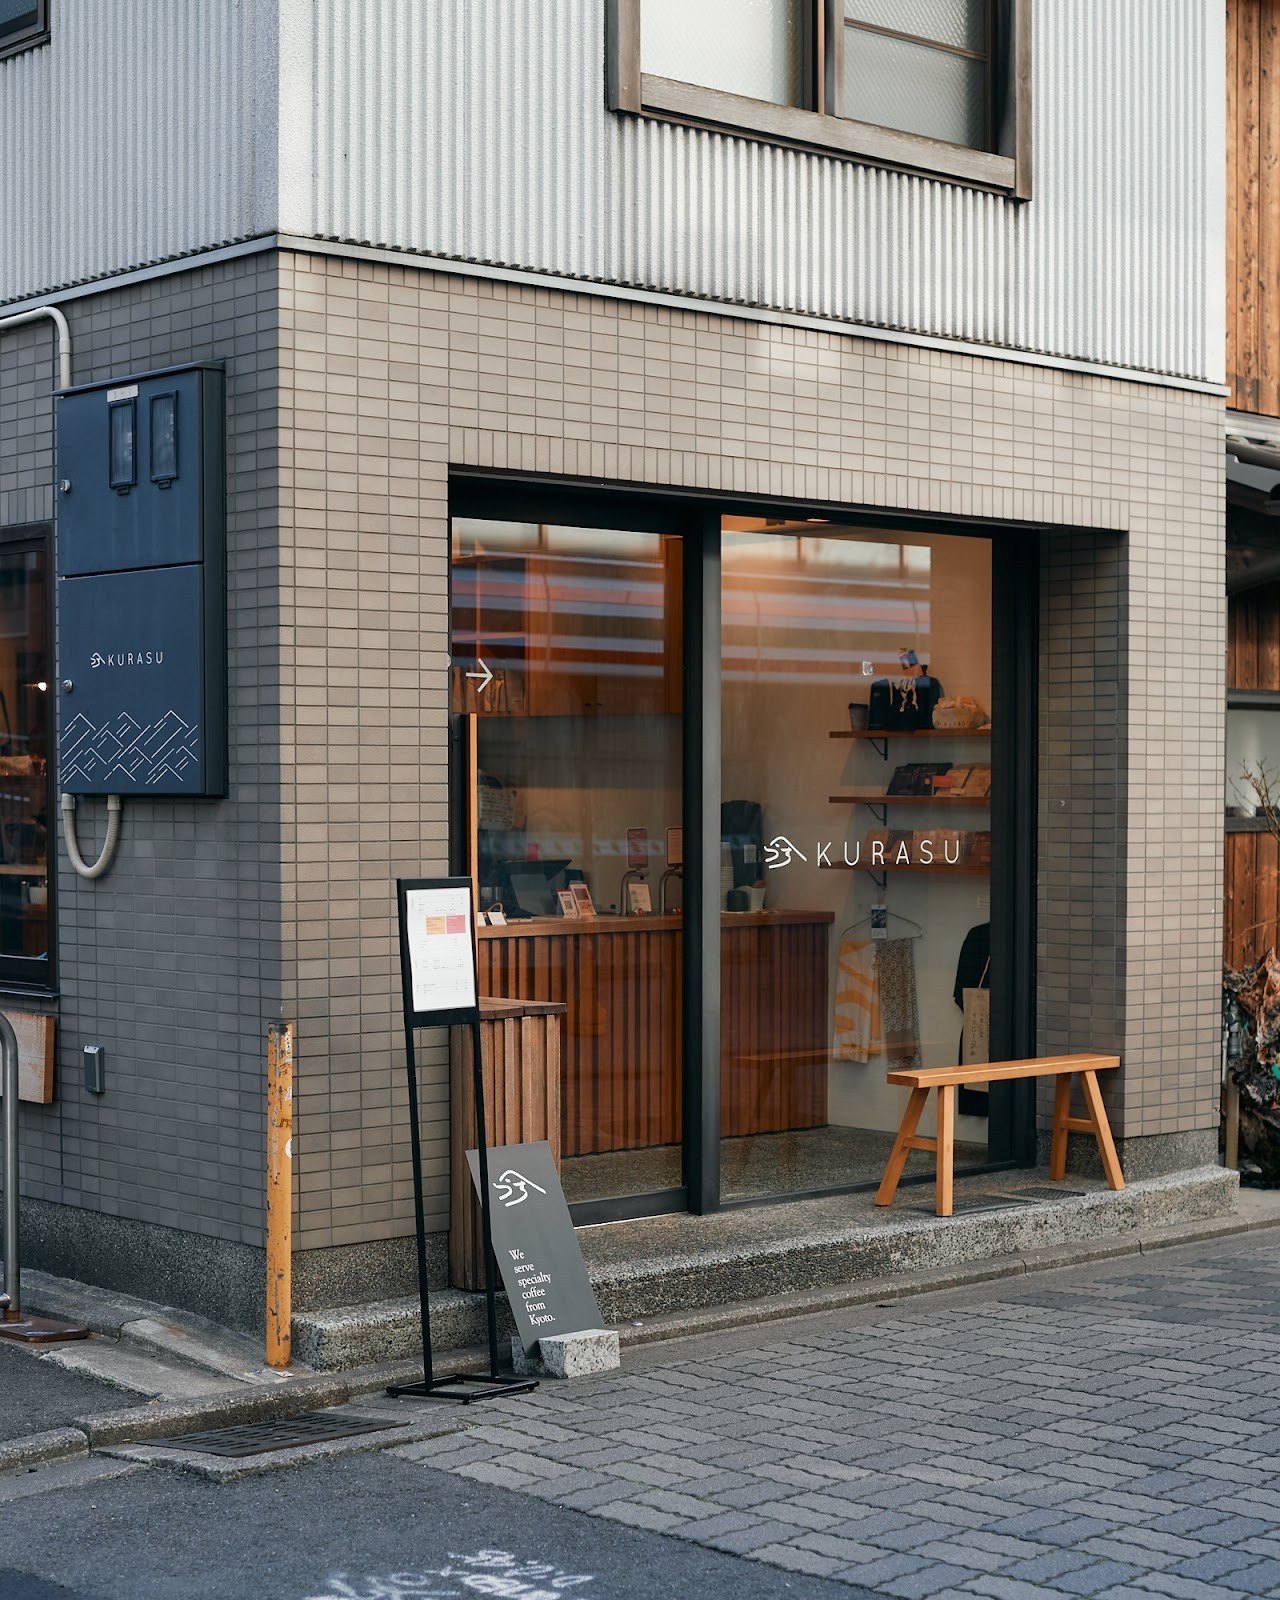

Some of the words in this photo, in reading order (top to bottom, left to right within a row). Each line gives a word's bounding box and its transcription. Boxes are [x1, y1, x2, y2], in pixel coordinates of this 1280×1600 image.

[108, 652, 163, 666] KURASU
[817, 840, 960, 867] KURASU
[508, 1249, 525, 1260] We
[514, 1263, 535, 1273] serve
[518, 1272, 551, 1288] specialty
[522, 1286, 546, 1299] coffee
[525, 1301, 546, 1312] from
[529, 1314, 556, 1326] Kyoto.
